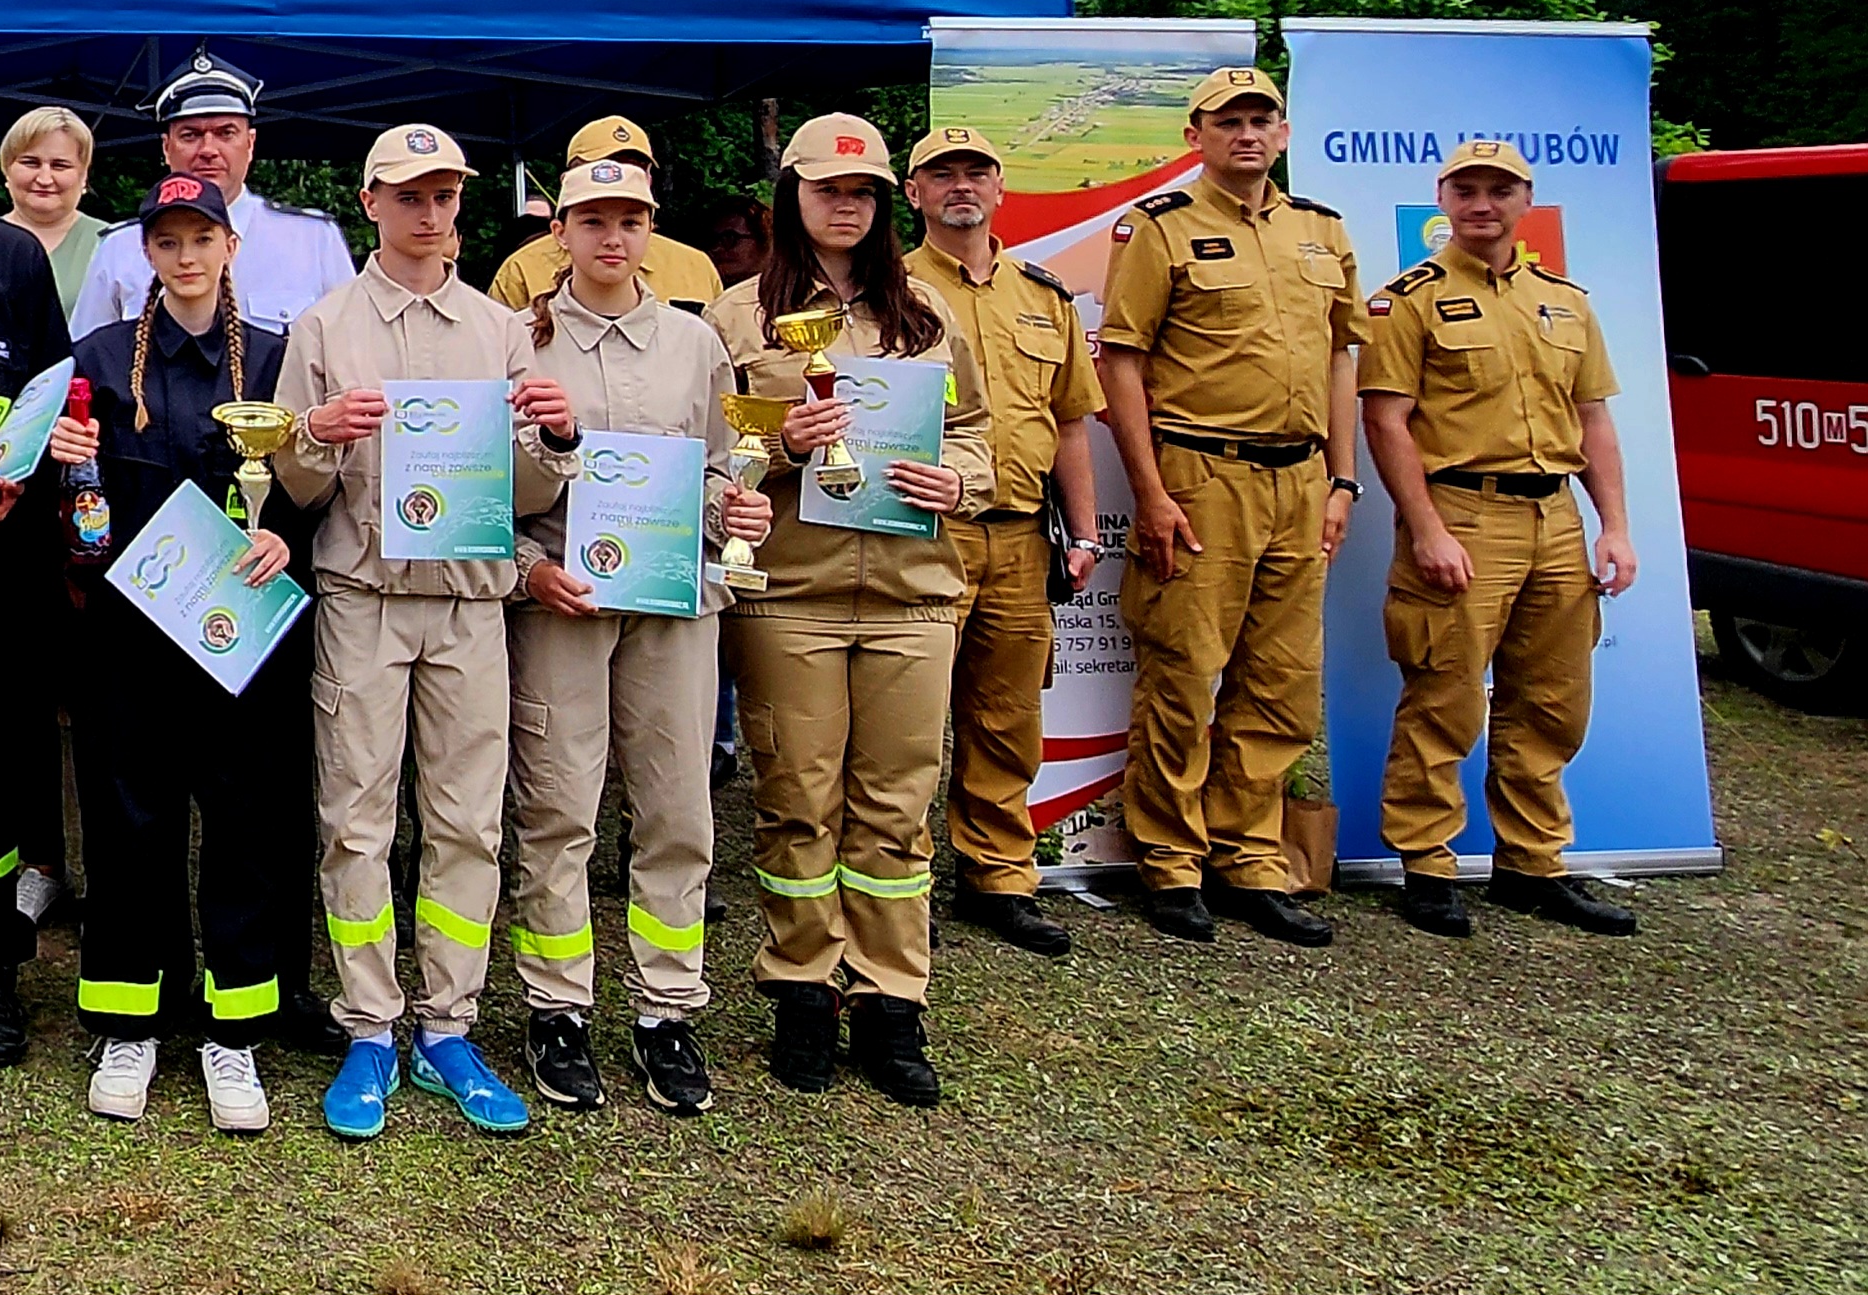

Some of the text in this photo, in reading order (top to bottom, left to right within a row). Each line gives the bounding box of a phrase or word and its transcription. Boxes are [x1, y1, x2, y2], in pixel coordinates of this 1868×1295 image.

[1324, 125, 1619, 166] GMINA UBÓW
[1066, 637, 1094, 651] 757
[1098, 636, 1117, 650] 91
